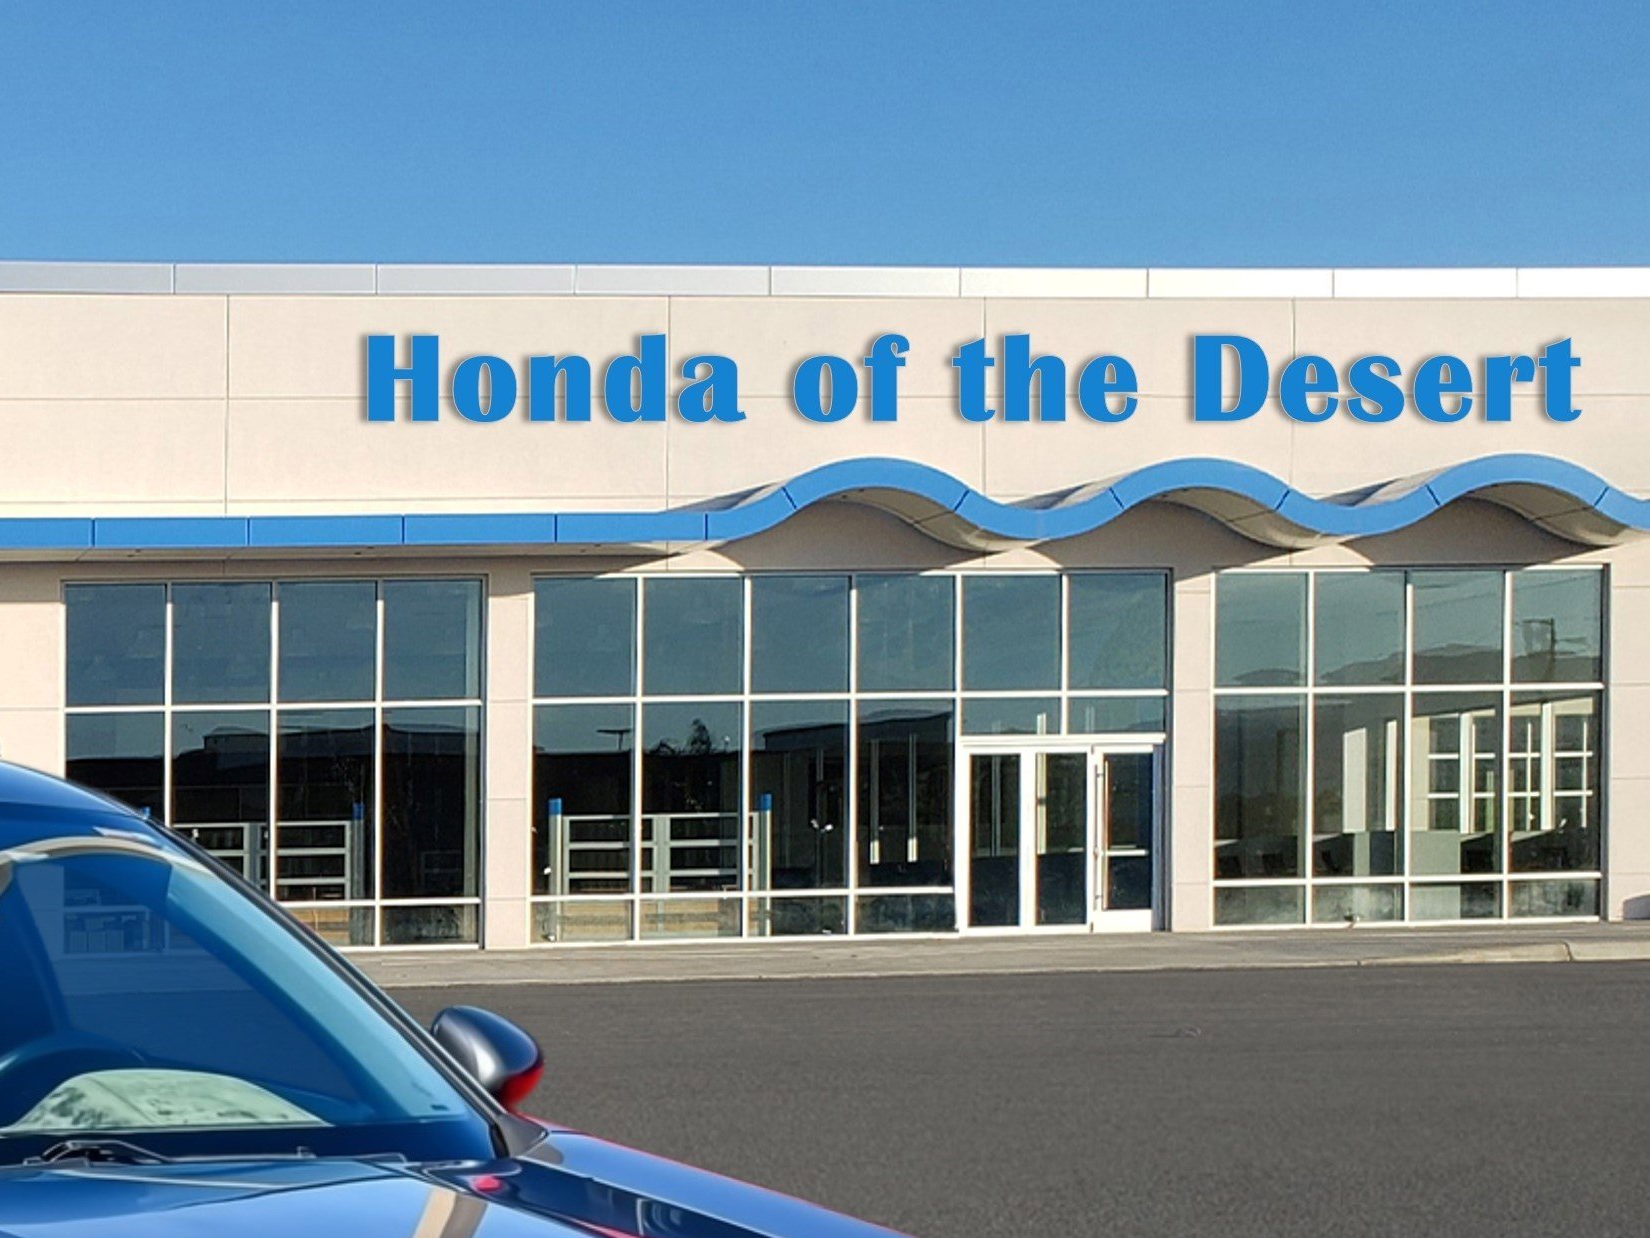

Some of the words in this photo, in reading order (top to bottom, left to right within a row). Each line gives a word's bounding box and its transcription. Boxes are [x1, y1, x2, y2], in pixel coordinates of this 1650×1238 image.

[367, 333, 747, 423] Honda
[793, 333, 911, 423] of
[951, 333, 1138, 423] the
[1194, 334, 1582, 423] Desert
